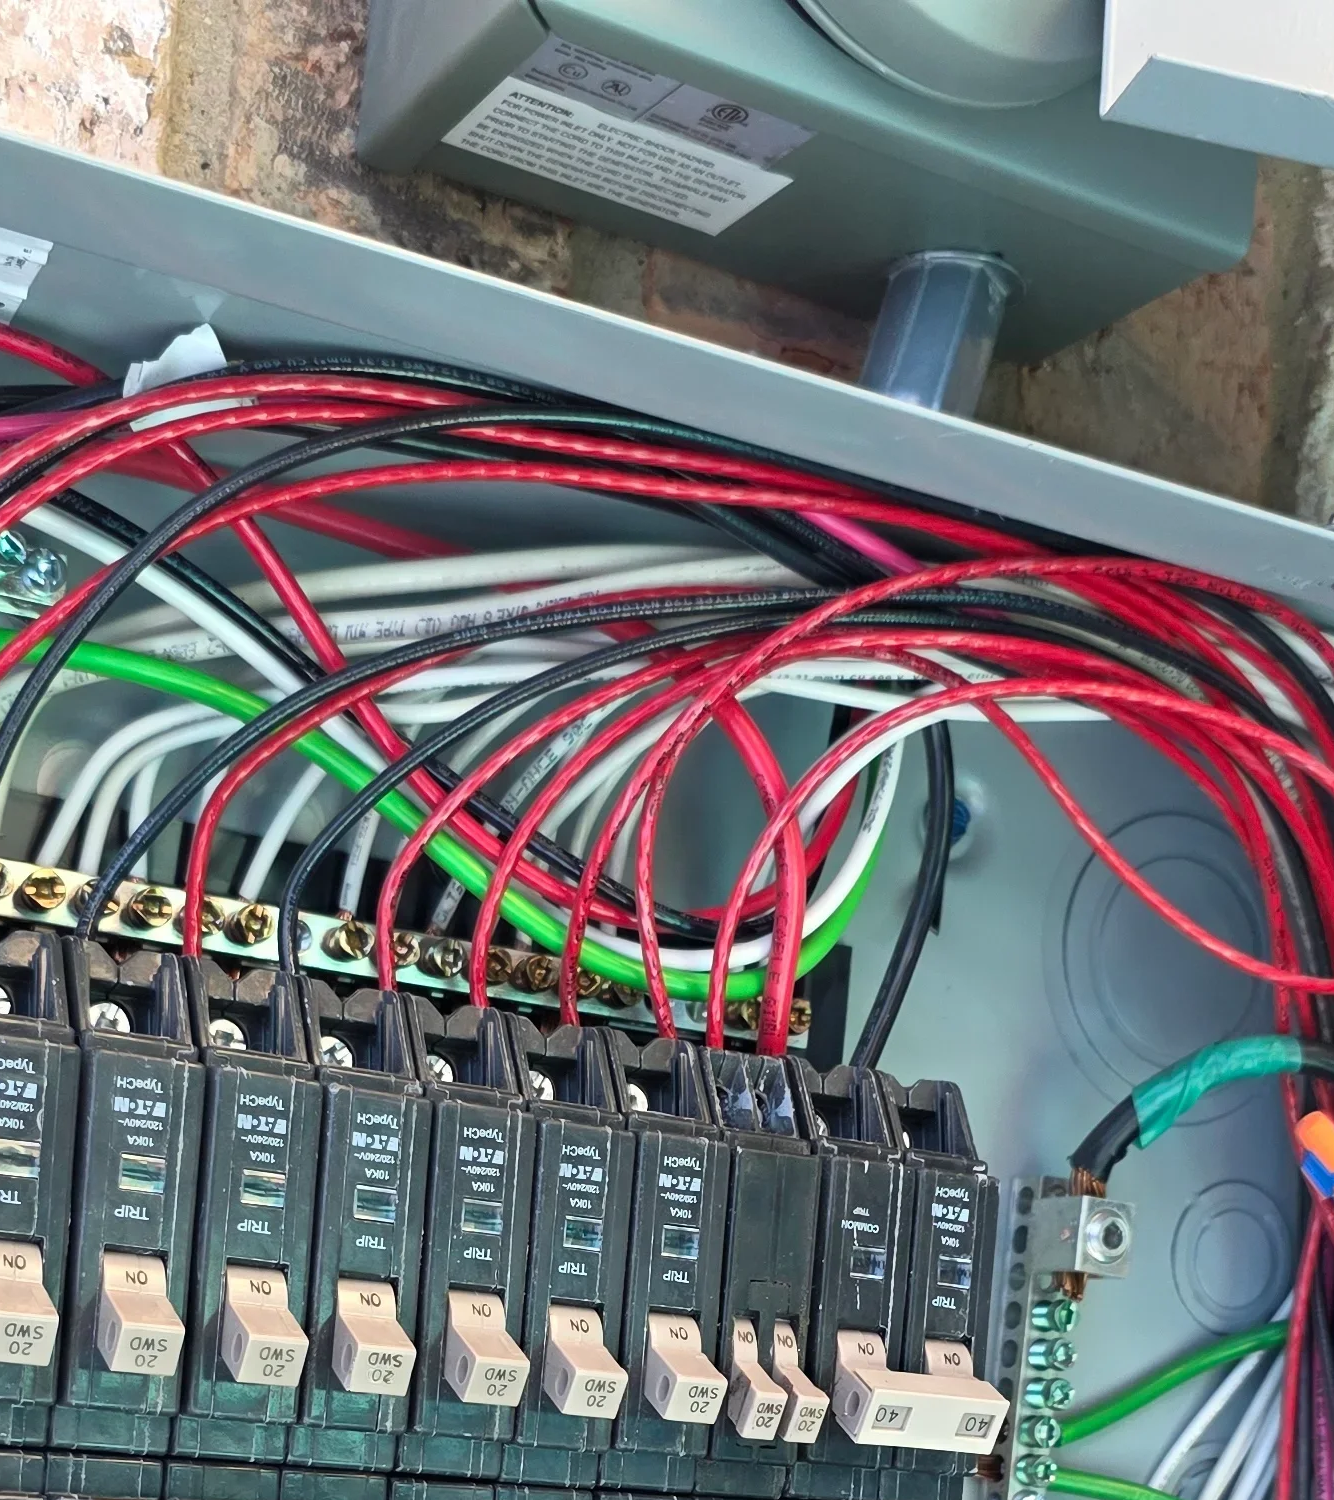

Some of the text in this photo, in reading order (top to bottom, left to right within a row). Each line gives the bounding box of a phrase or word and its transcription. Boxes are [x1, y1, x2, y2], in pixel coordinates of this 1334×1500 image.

[508, 91, 574, 118] ATTENTION:
[500, 99, 522, 110] FOR
[523, 107, 559, 123] POWER
[559, 120, 586, 133] INLET
[615, 140, 638, 151] NOT
[637, 148, 658, 158] FOR
[657, 155, 678, 165] USE
[677, 162, 692, 171] AS
[691, 167, 705, 175] AN
[596, 123, 643, 142] ELECTRIC
[643, 140, 676, 154] SHOCK
[114, 1097, 166, 1117] EATON
[237, 1114, 287, 1134] EATON
[460, 1146, 504, 1165] EATON
[114, 1205, 149, 1220] TRIP
[237, 1220, 271, 1234] TRIP
[464, 1247, 493, 1261] TRIP
[3, 1254, 26, 1270] ON
[125, 1269, 148, 1285] ON
[250, 1280, 272, 1295] ON
[360, 1293, 381, 1307] ON
[4, 1322, 44, 1340] SWD
[9, 1340, 33, 1356] 20
[130, 1336, 168, 1353] SWD
[134, 1354, 158, 1369] 20
[259, 1347, 295, 1362] SWD
[368, 1351, 403, 1367] SWD
[262, 1364, 284, 1377] 20
[484, 1367, 517, 1382] SWD
[487, 1383, 508, 1397] 20
[584, 1379, 616, 1393] SWD
[688, 1386, 718, 1401] SWD
[586, 1395, 607, 1408] 20
[690, 1401, 709, 1413] 20
[876, 1408, 899, 1423] 40
[966, 1417, 988, 1431] 40
